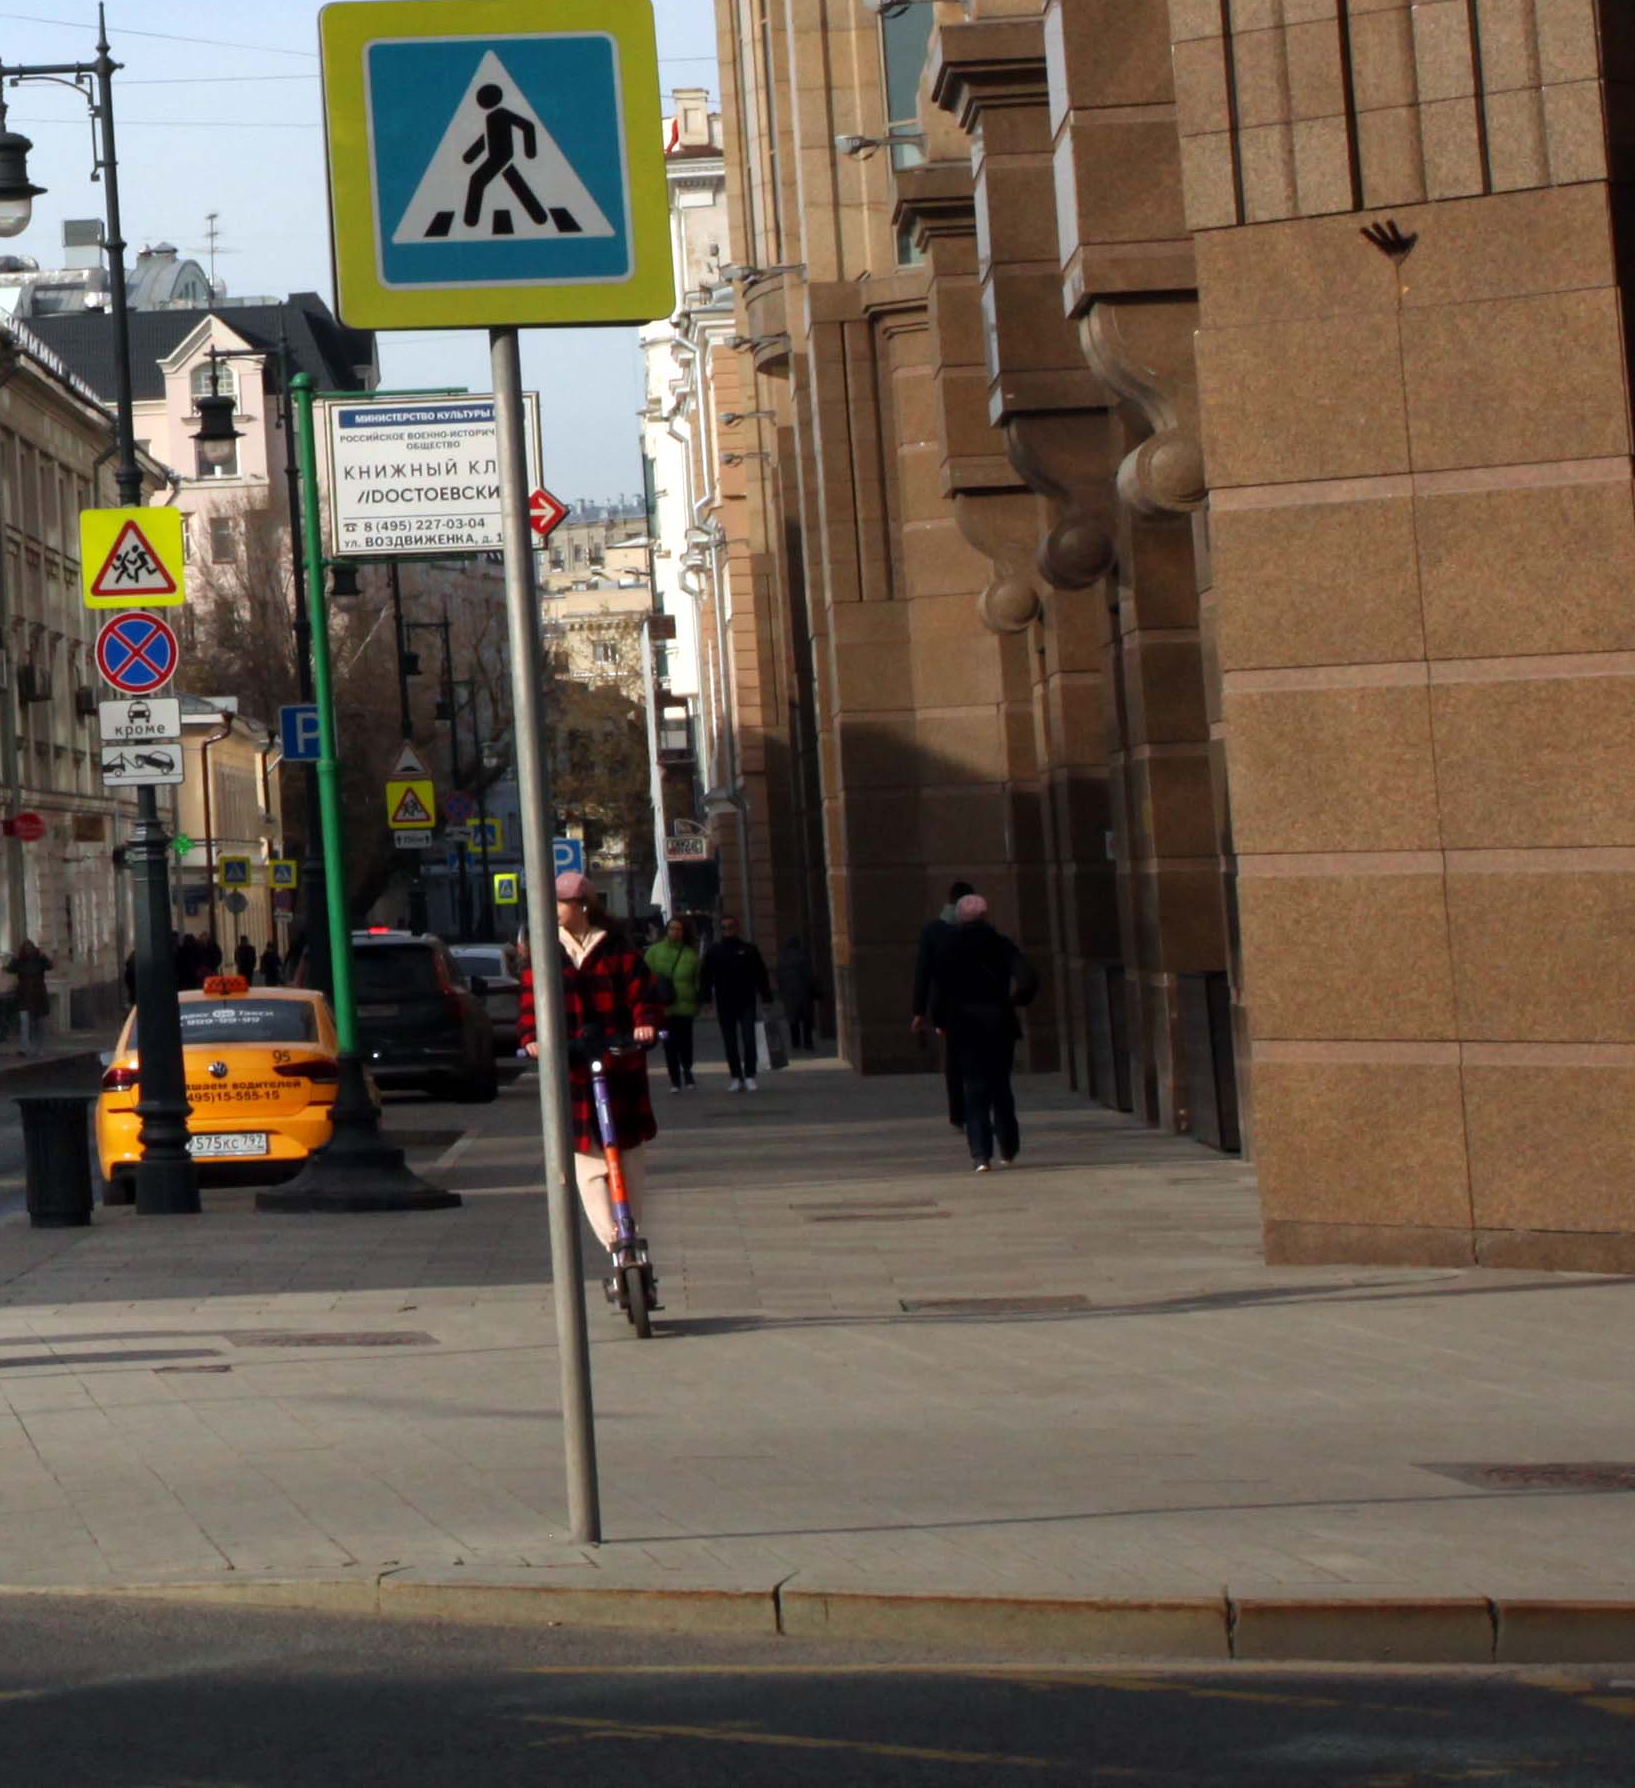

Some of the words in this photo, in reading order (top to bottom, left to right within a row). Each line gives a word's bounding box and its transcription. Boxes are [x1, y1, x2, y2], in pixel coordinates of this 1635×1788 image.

[354, 411, 435, 424] МИНИСТЕРСТВО
[436, 408, 491, 421] КУЛЬТУРЫ
[339, 431, 405, 444] РОССИЙСКОЕ
[406, 440, 461, 452] ОБЩЕСТВО
[344, 458, 458, 481] КНИЖНЫЙ
[363, 521, 373, 533] 8
[376, 519, 412, 533] (495)
[415, 518, 485, 531] 227-03-04
[344, 539, 361, 549] ул.
[365, 533, 479, 549] ВОЗДВИЖЕНКА,
[482, 535, 493, 545] д.
[114, 723, 166, 739] кроме
[272, 1050, 291, 1063] 95
[232, 1079, 301, 1090] водителей
